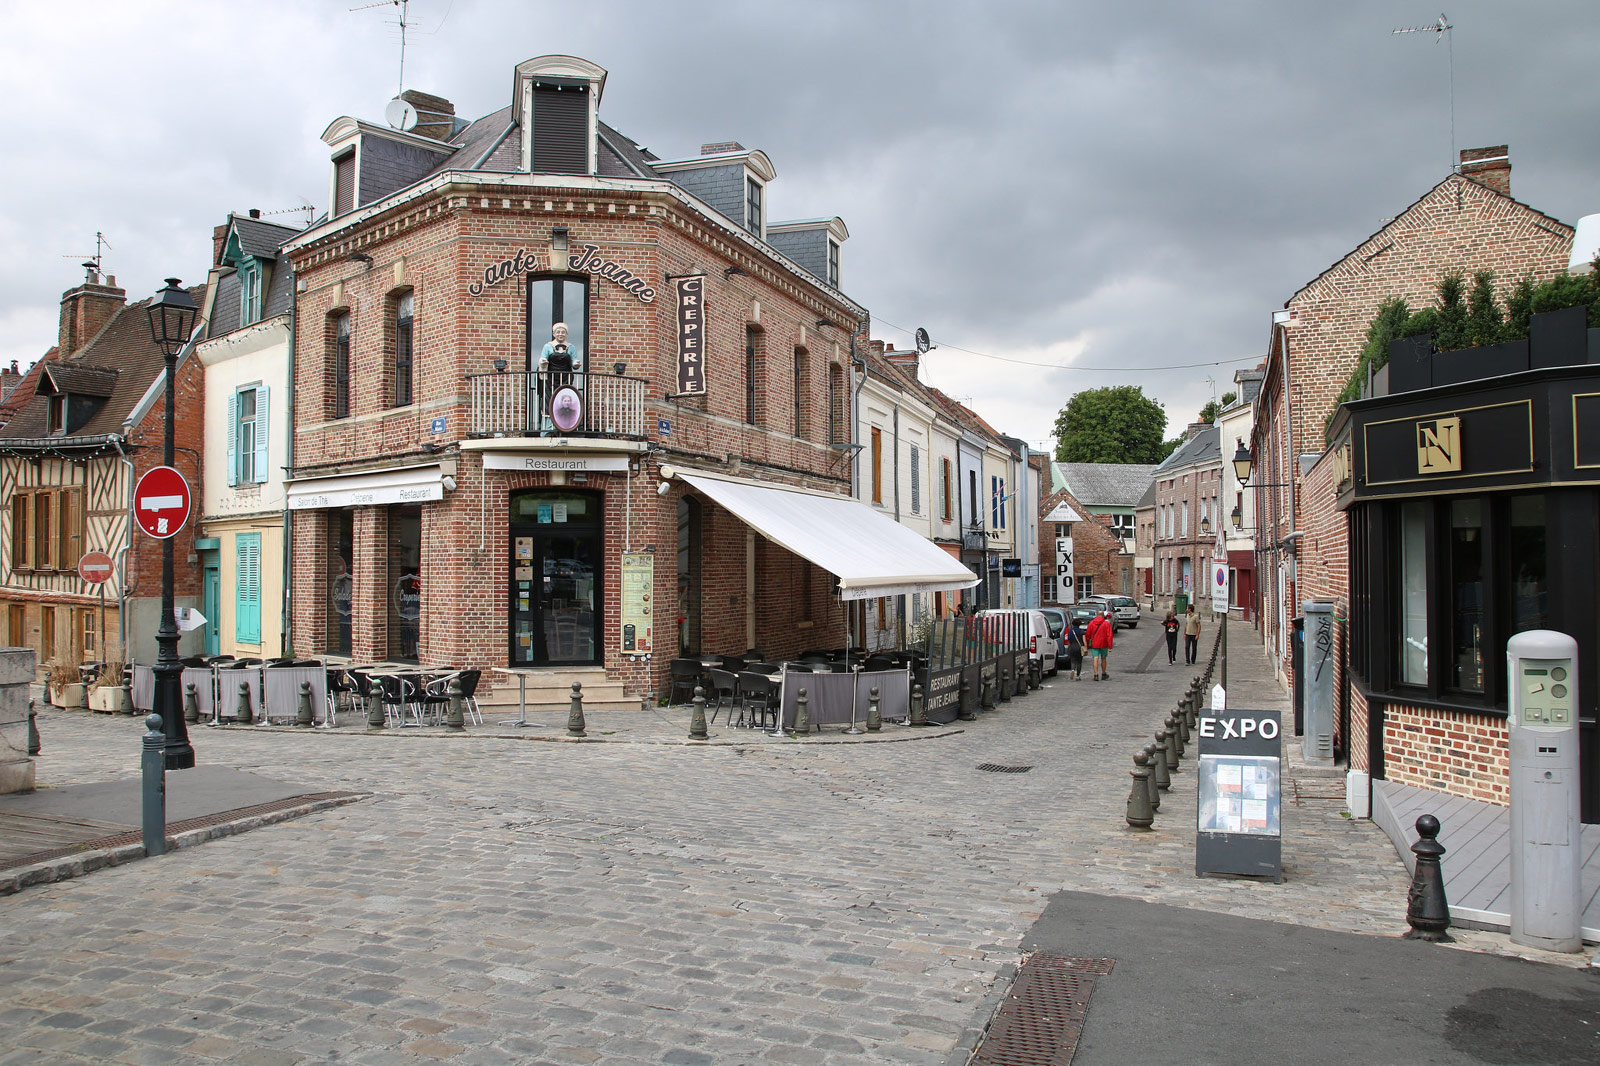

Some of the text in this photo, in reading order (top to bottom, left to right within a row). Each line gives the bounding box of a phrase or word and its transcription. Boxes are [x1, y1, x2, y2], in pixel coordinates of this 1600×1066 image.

[568, 244, 656, 303] Jeanne
[682, 280, 700, 392] CREPERIE
[1420, 424, 1456, 468] N
[525, 458, 588, 470] Restaurant
[399, 488, 432, 500] Restaurant
[1057, 540, 1073, 588] EXPO
[930, 672, 960, 691] RESTAURANT
[1199, 717, 1279, 740] EXPO
